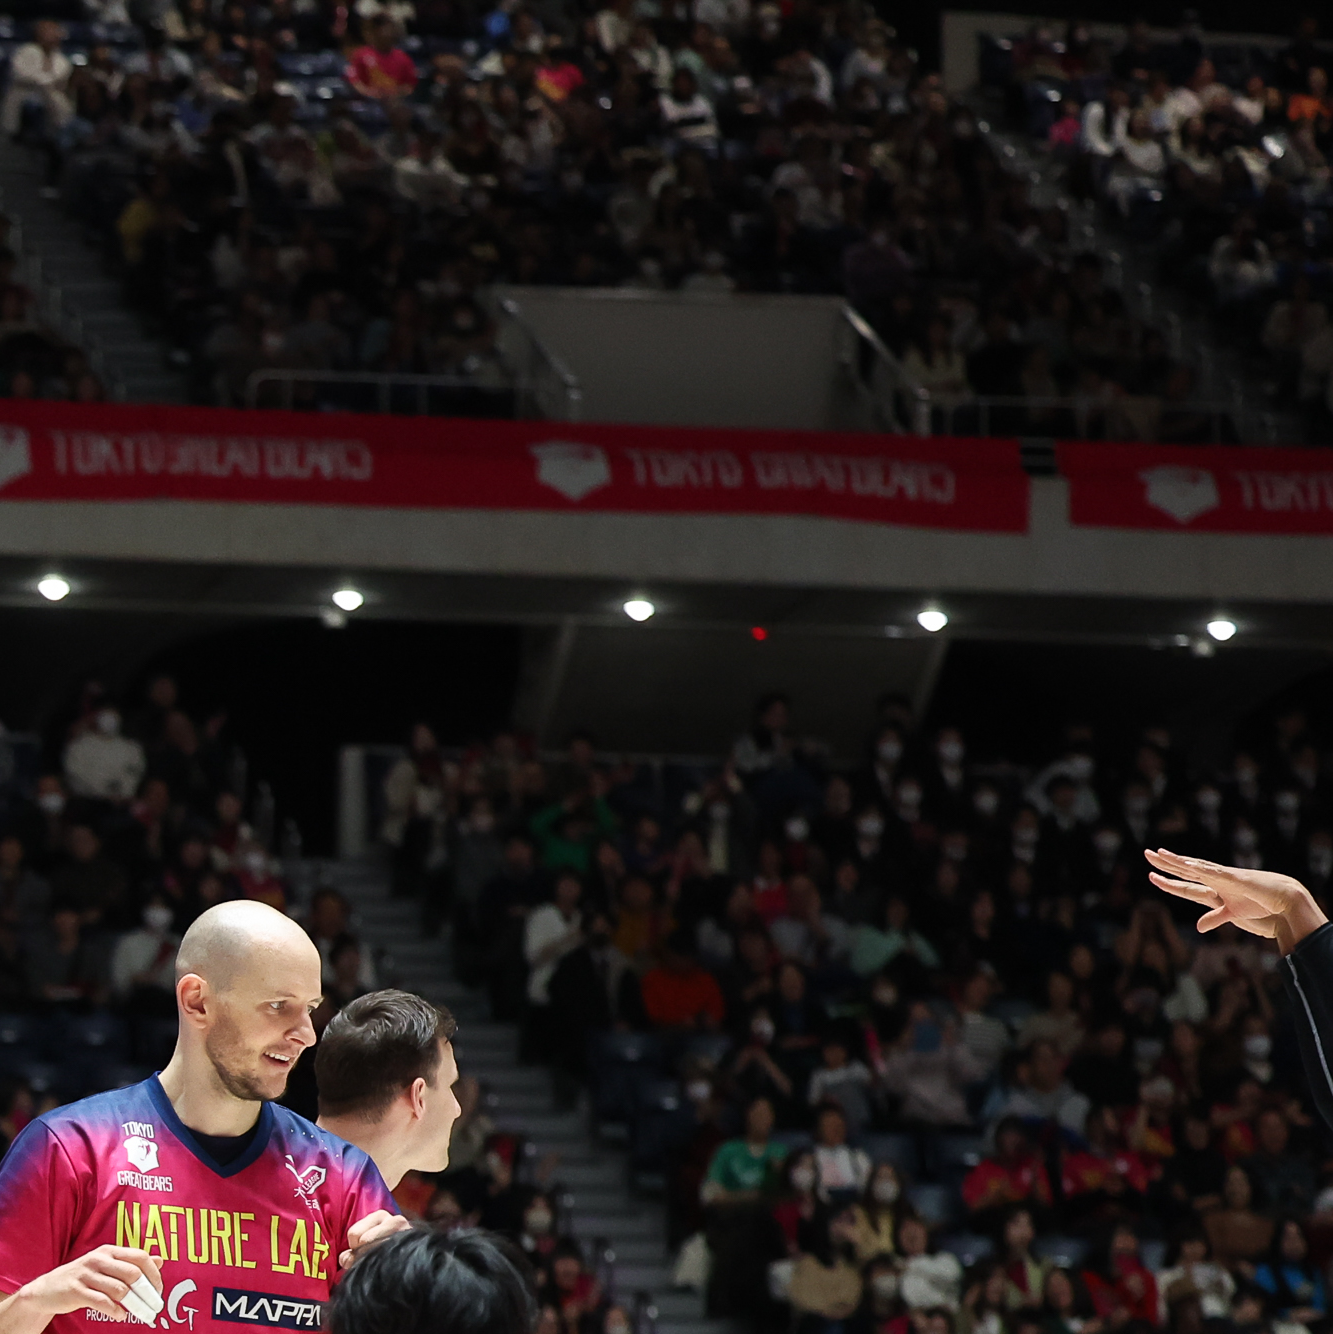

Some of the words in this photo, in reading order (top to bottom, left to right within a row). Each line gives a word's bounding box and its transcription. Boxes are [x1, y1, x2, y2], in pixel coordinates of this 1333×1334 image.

[1236, 469, 1333, 512] TOKY
[122, 1121, 155, 1139] TOKYO
[117, 1170, 173, 1192] GREATBEARS
[115, 1200, 257, 1269] NATURE
[270, 1215, 330, 1280] LAB
[86, 1309, 151, 1326] PRODTION
[215, 1292, 321, 1326] MAPPA
